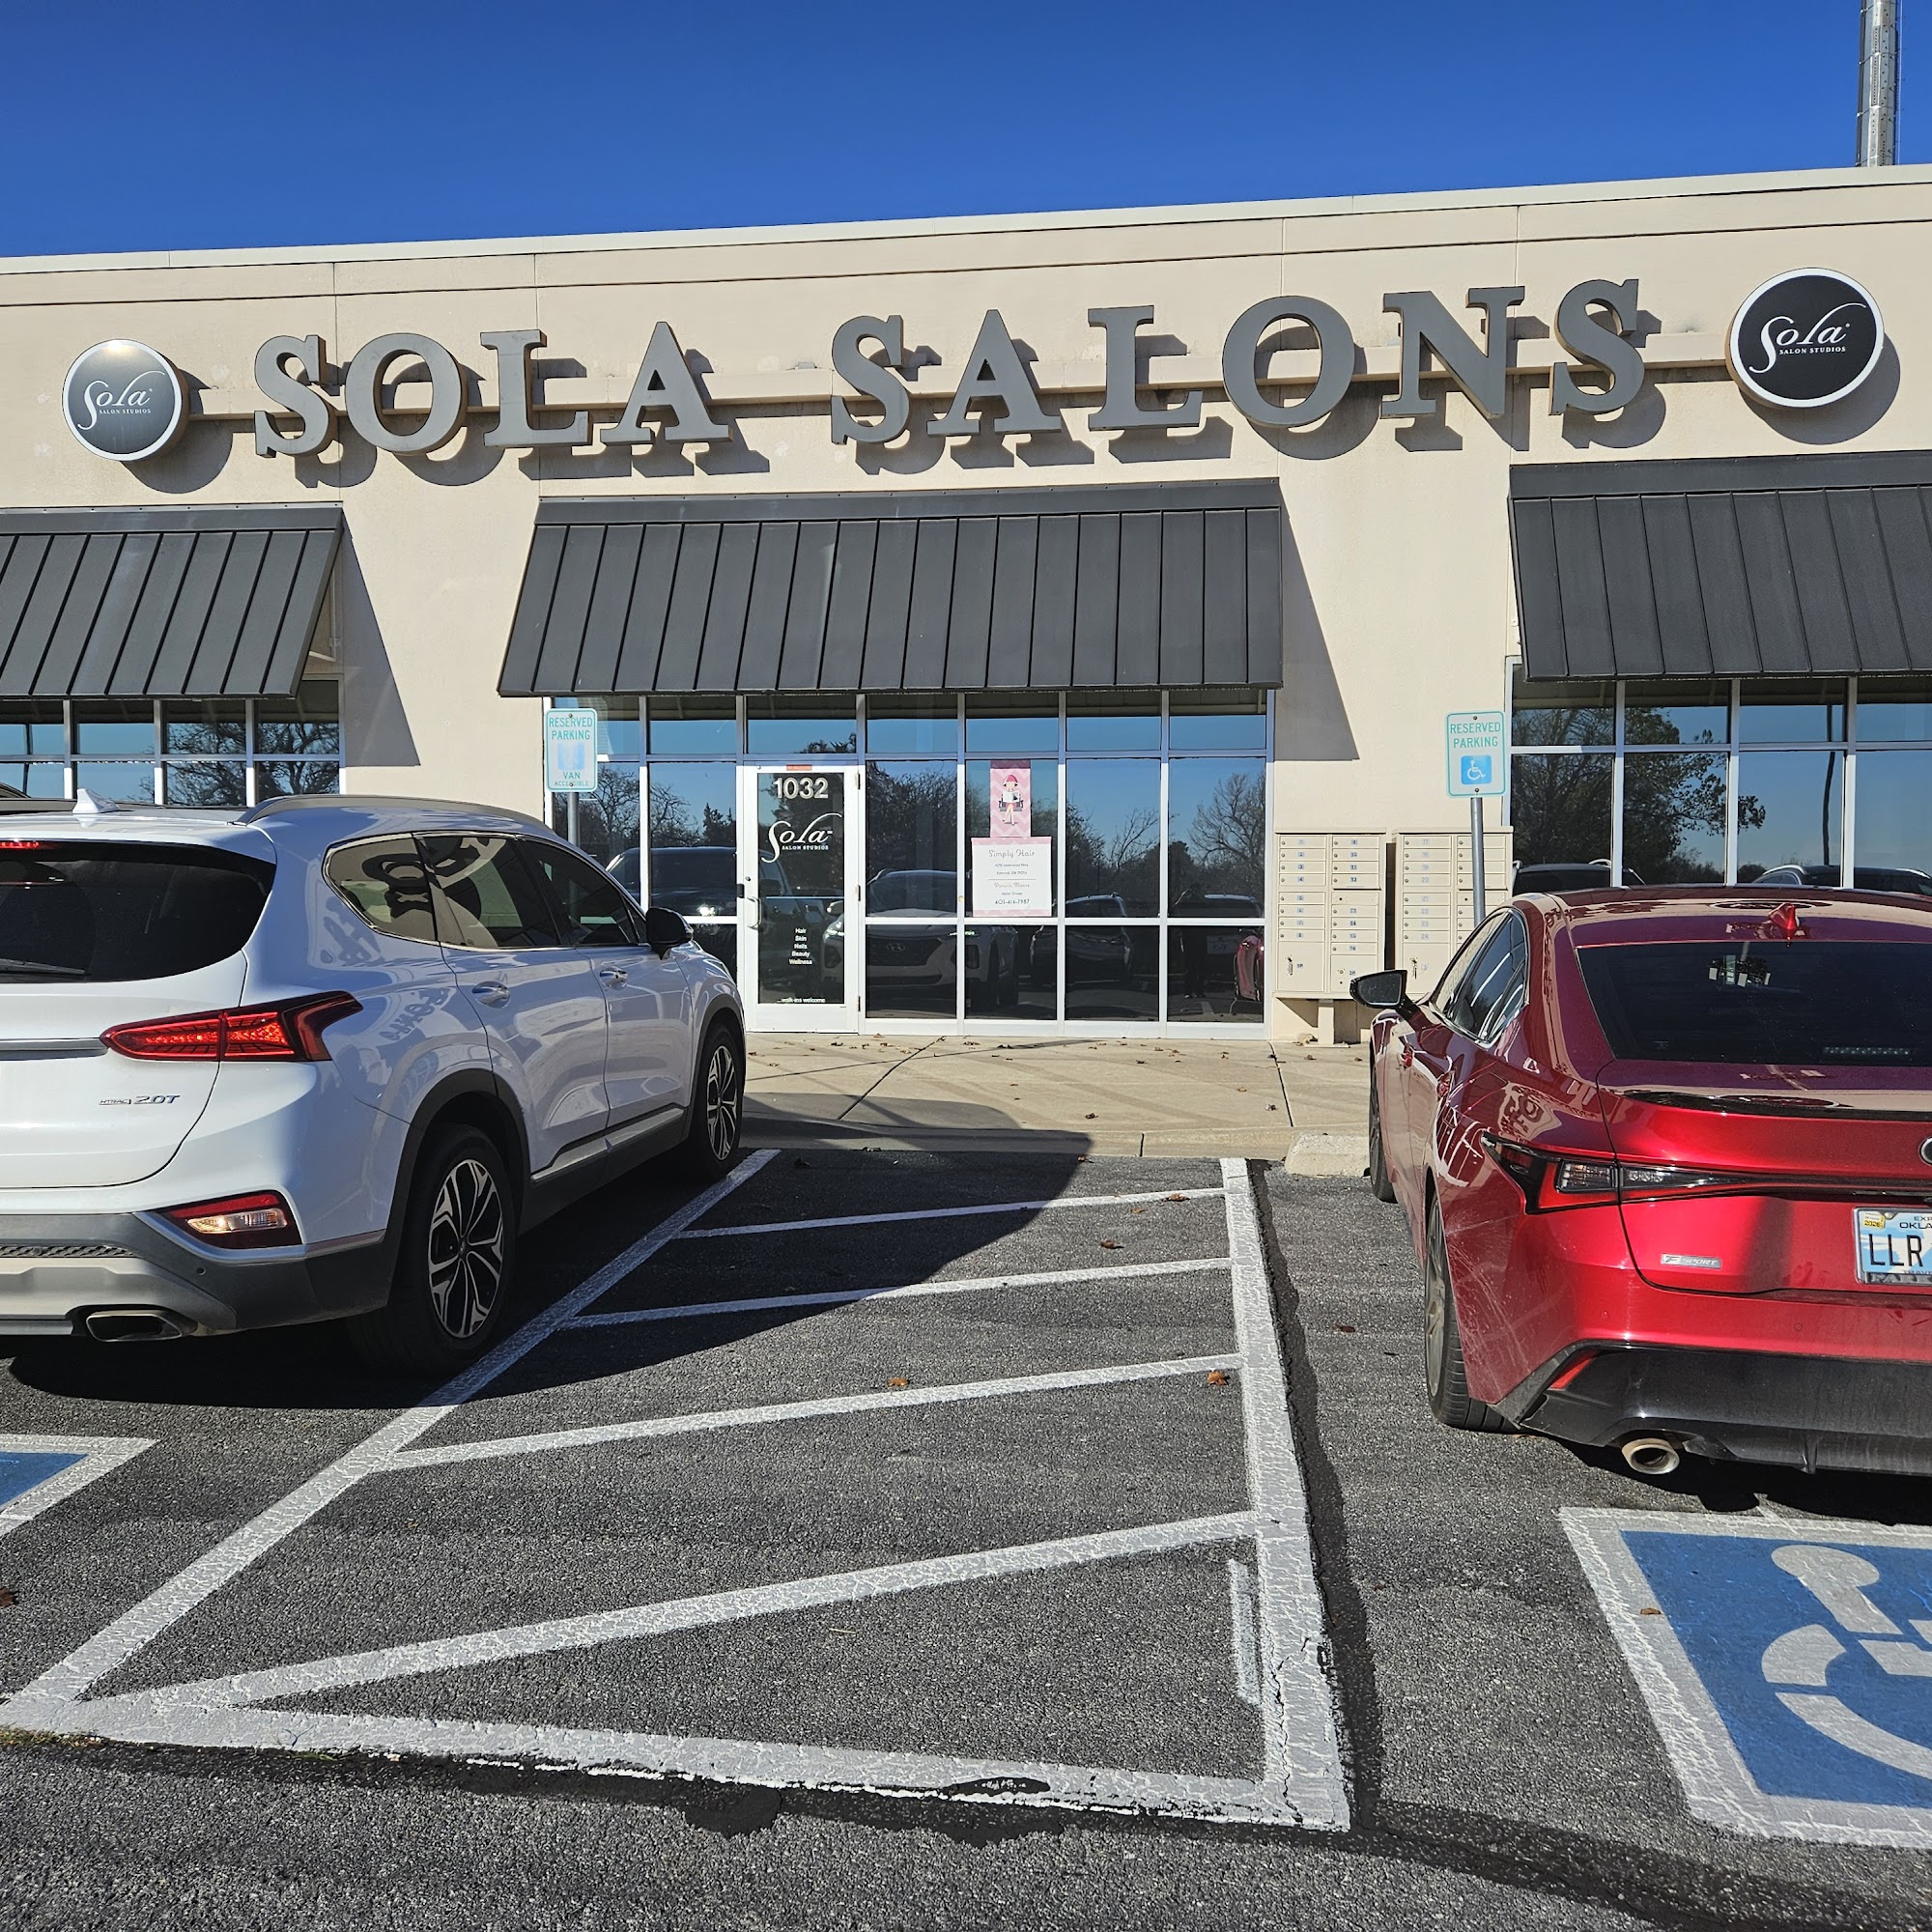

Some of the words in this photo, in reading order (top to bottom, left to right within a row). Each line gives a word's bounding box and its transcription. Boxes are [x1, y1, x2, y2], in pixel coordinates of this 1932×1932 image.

[1748, 302, 1867, 374] Sola
[254, 321, 733, 458] SOLA
[831, 278, 1639, 445] SALONS
[77, 370, 165, 430] Sola
[549, 717, 593, 727] RESERVED
[552, 730, 590, 740] PARKING
[1450, 722, 1501, 734] RESERVED
[1453, 736, 1498, 749] PARKING
[774, 777, 829, 799] 1032
[761, 812, 842, 863] Sola
[1869, 1234, 1923, 1267] LLR
